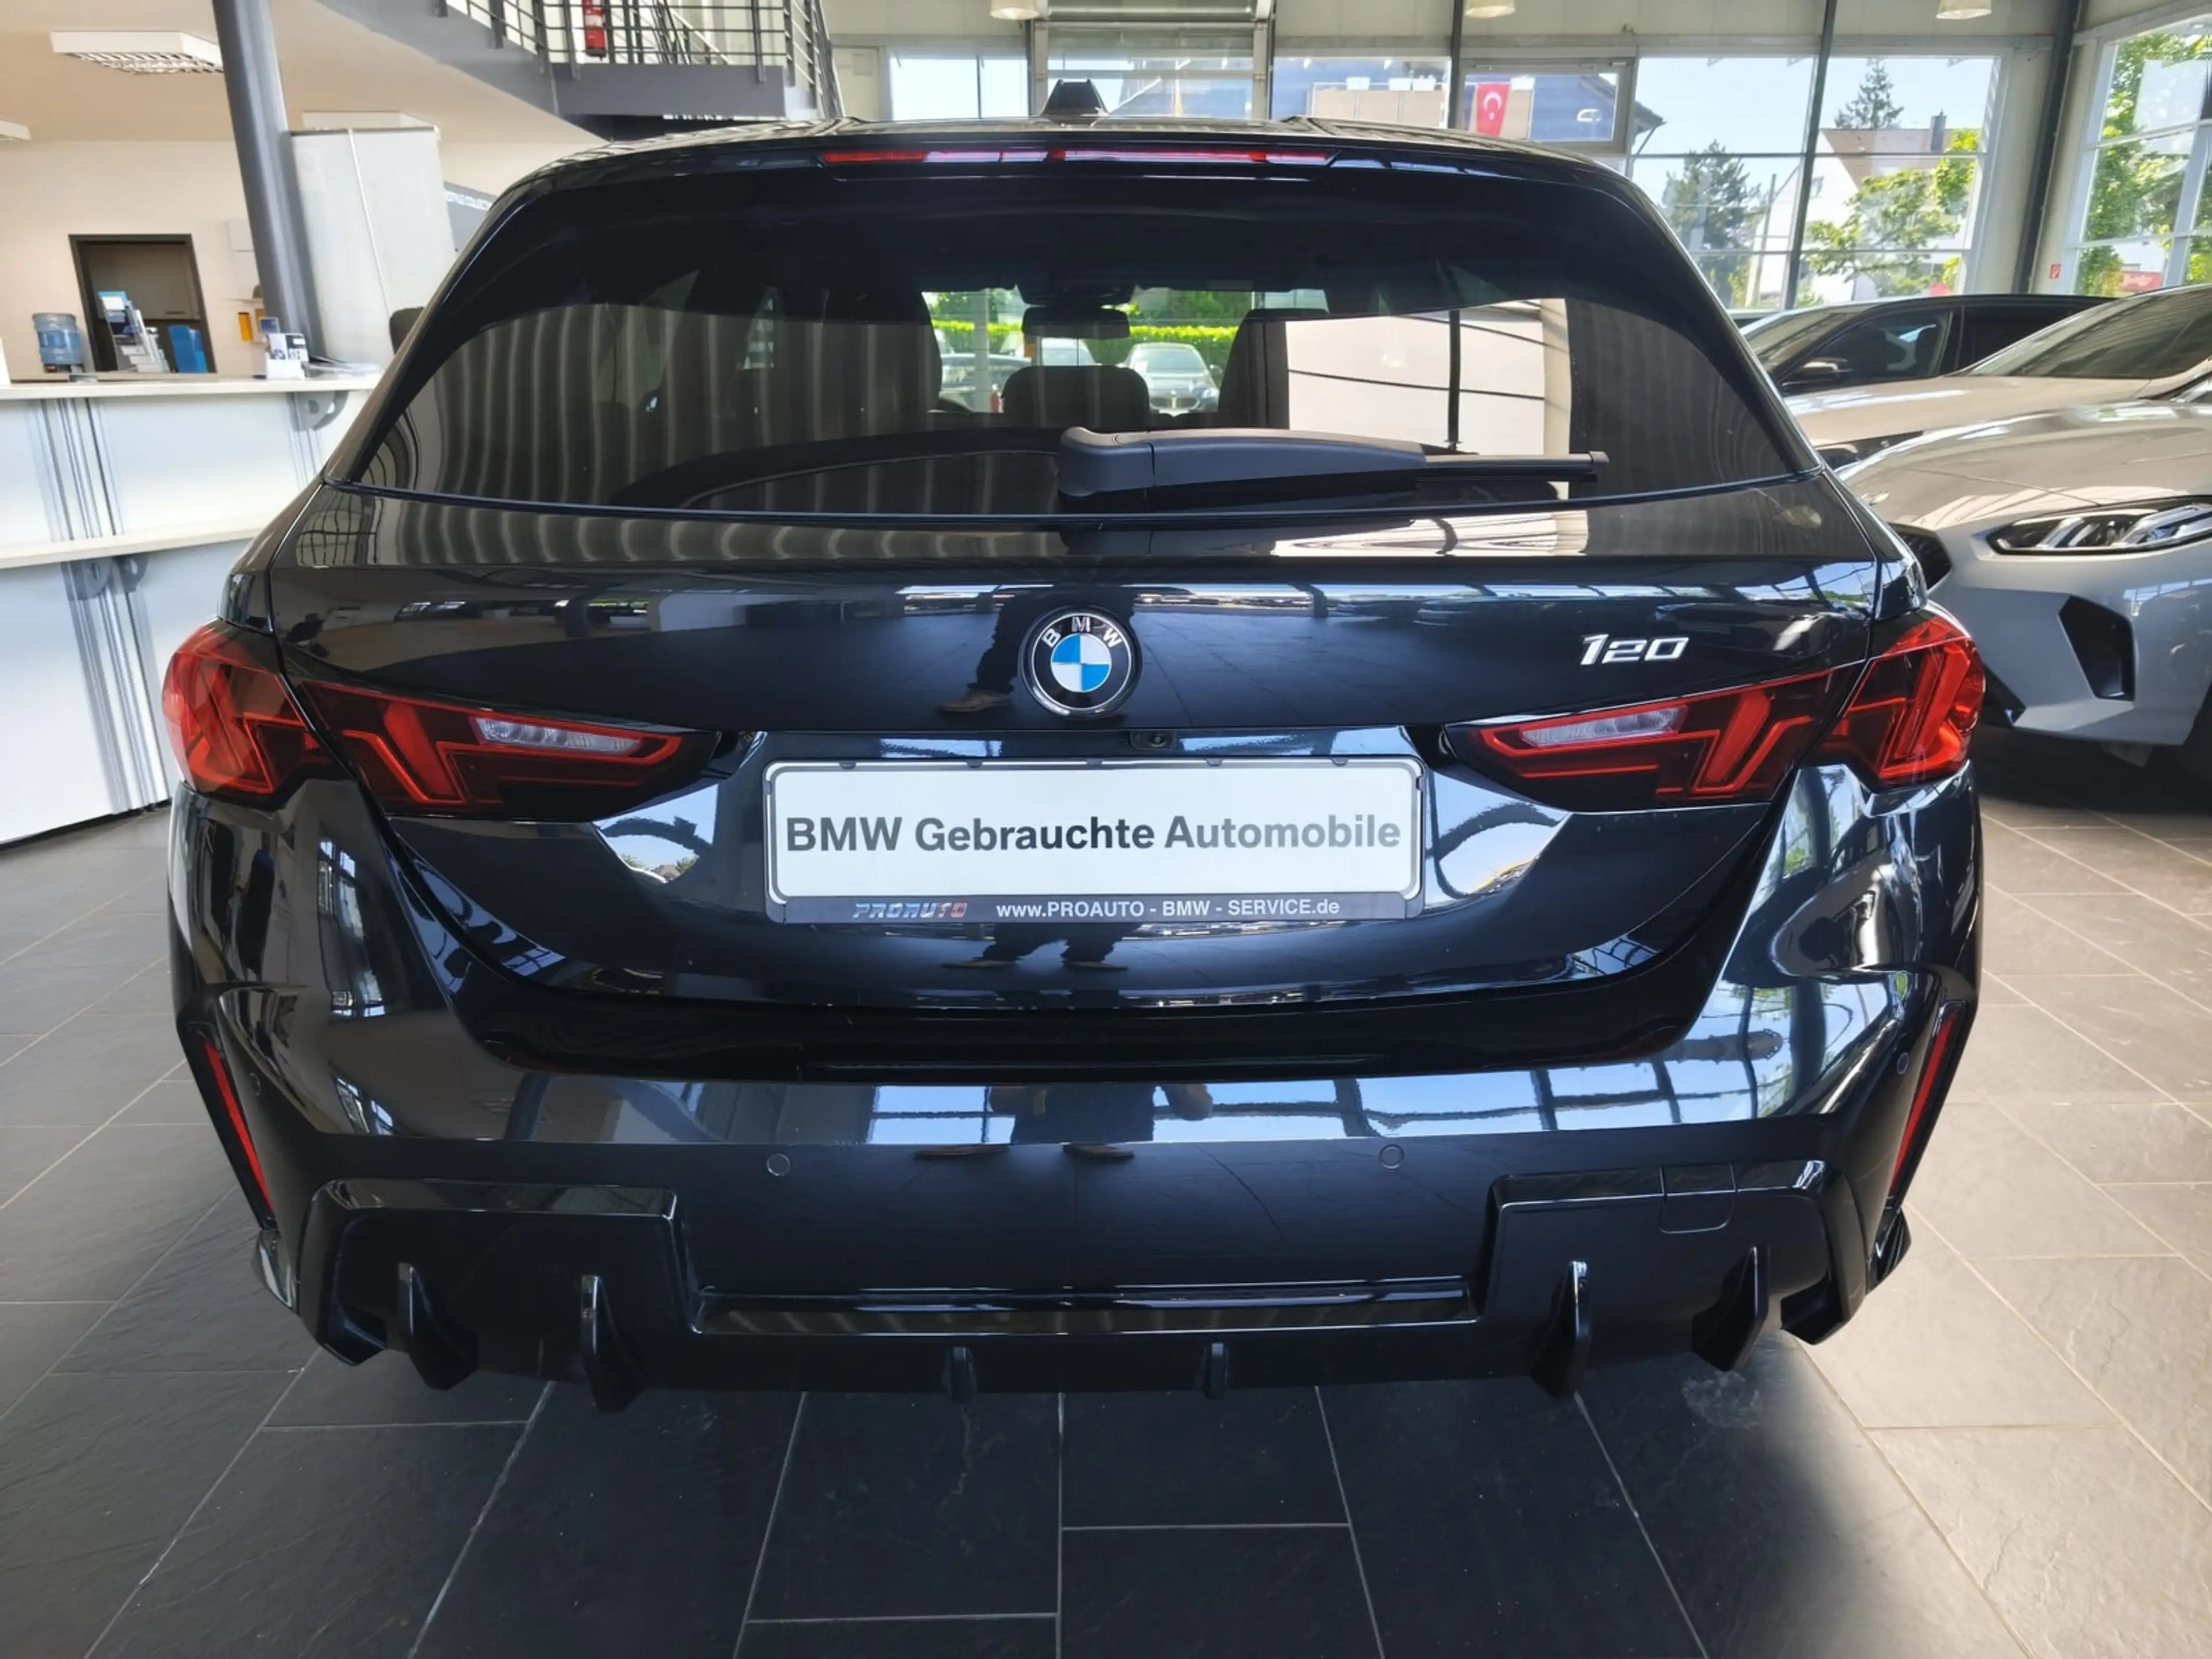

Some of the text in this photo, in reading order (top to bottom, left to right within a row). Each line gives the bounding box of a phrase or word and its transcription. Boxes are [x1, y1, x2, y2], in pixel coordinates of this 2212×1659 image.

[1041, 616, 1123, 649] BMW
[1579, 633, 1690, 666] 120
[786, 813, 1402, 851] BMW Gebrauchte Automobile
[852, 902, 968, 919] PROAUTO
[996, 901, 1145, 918] www.PROAUTO
[1162, 900, 1211, 917] BMW
[1228, 899, 1340, 916] SERVICE.de
